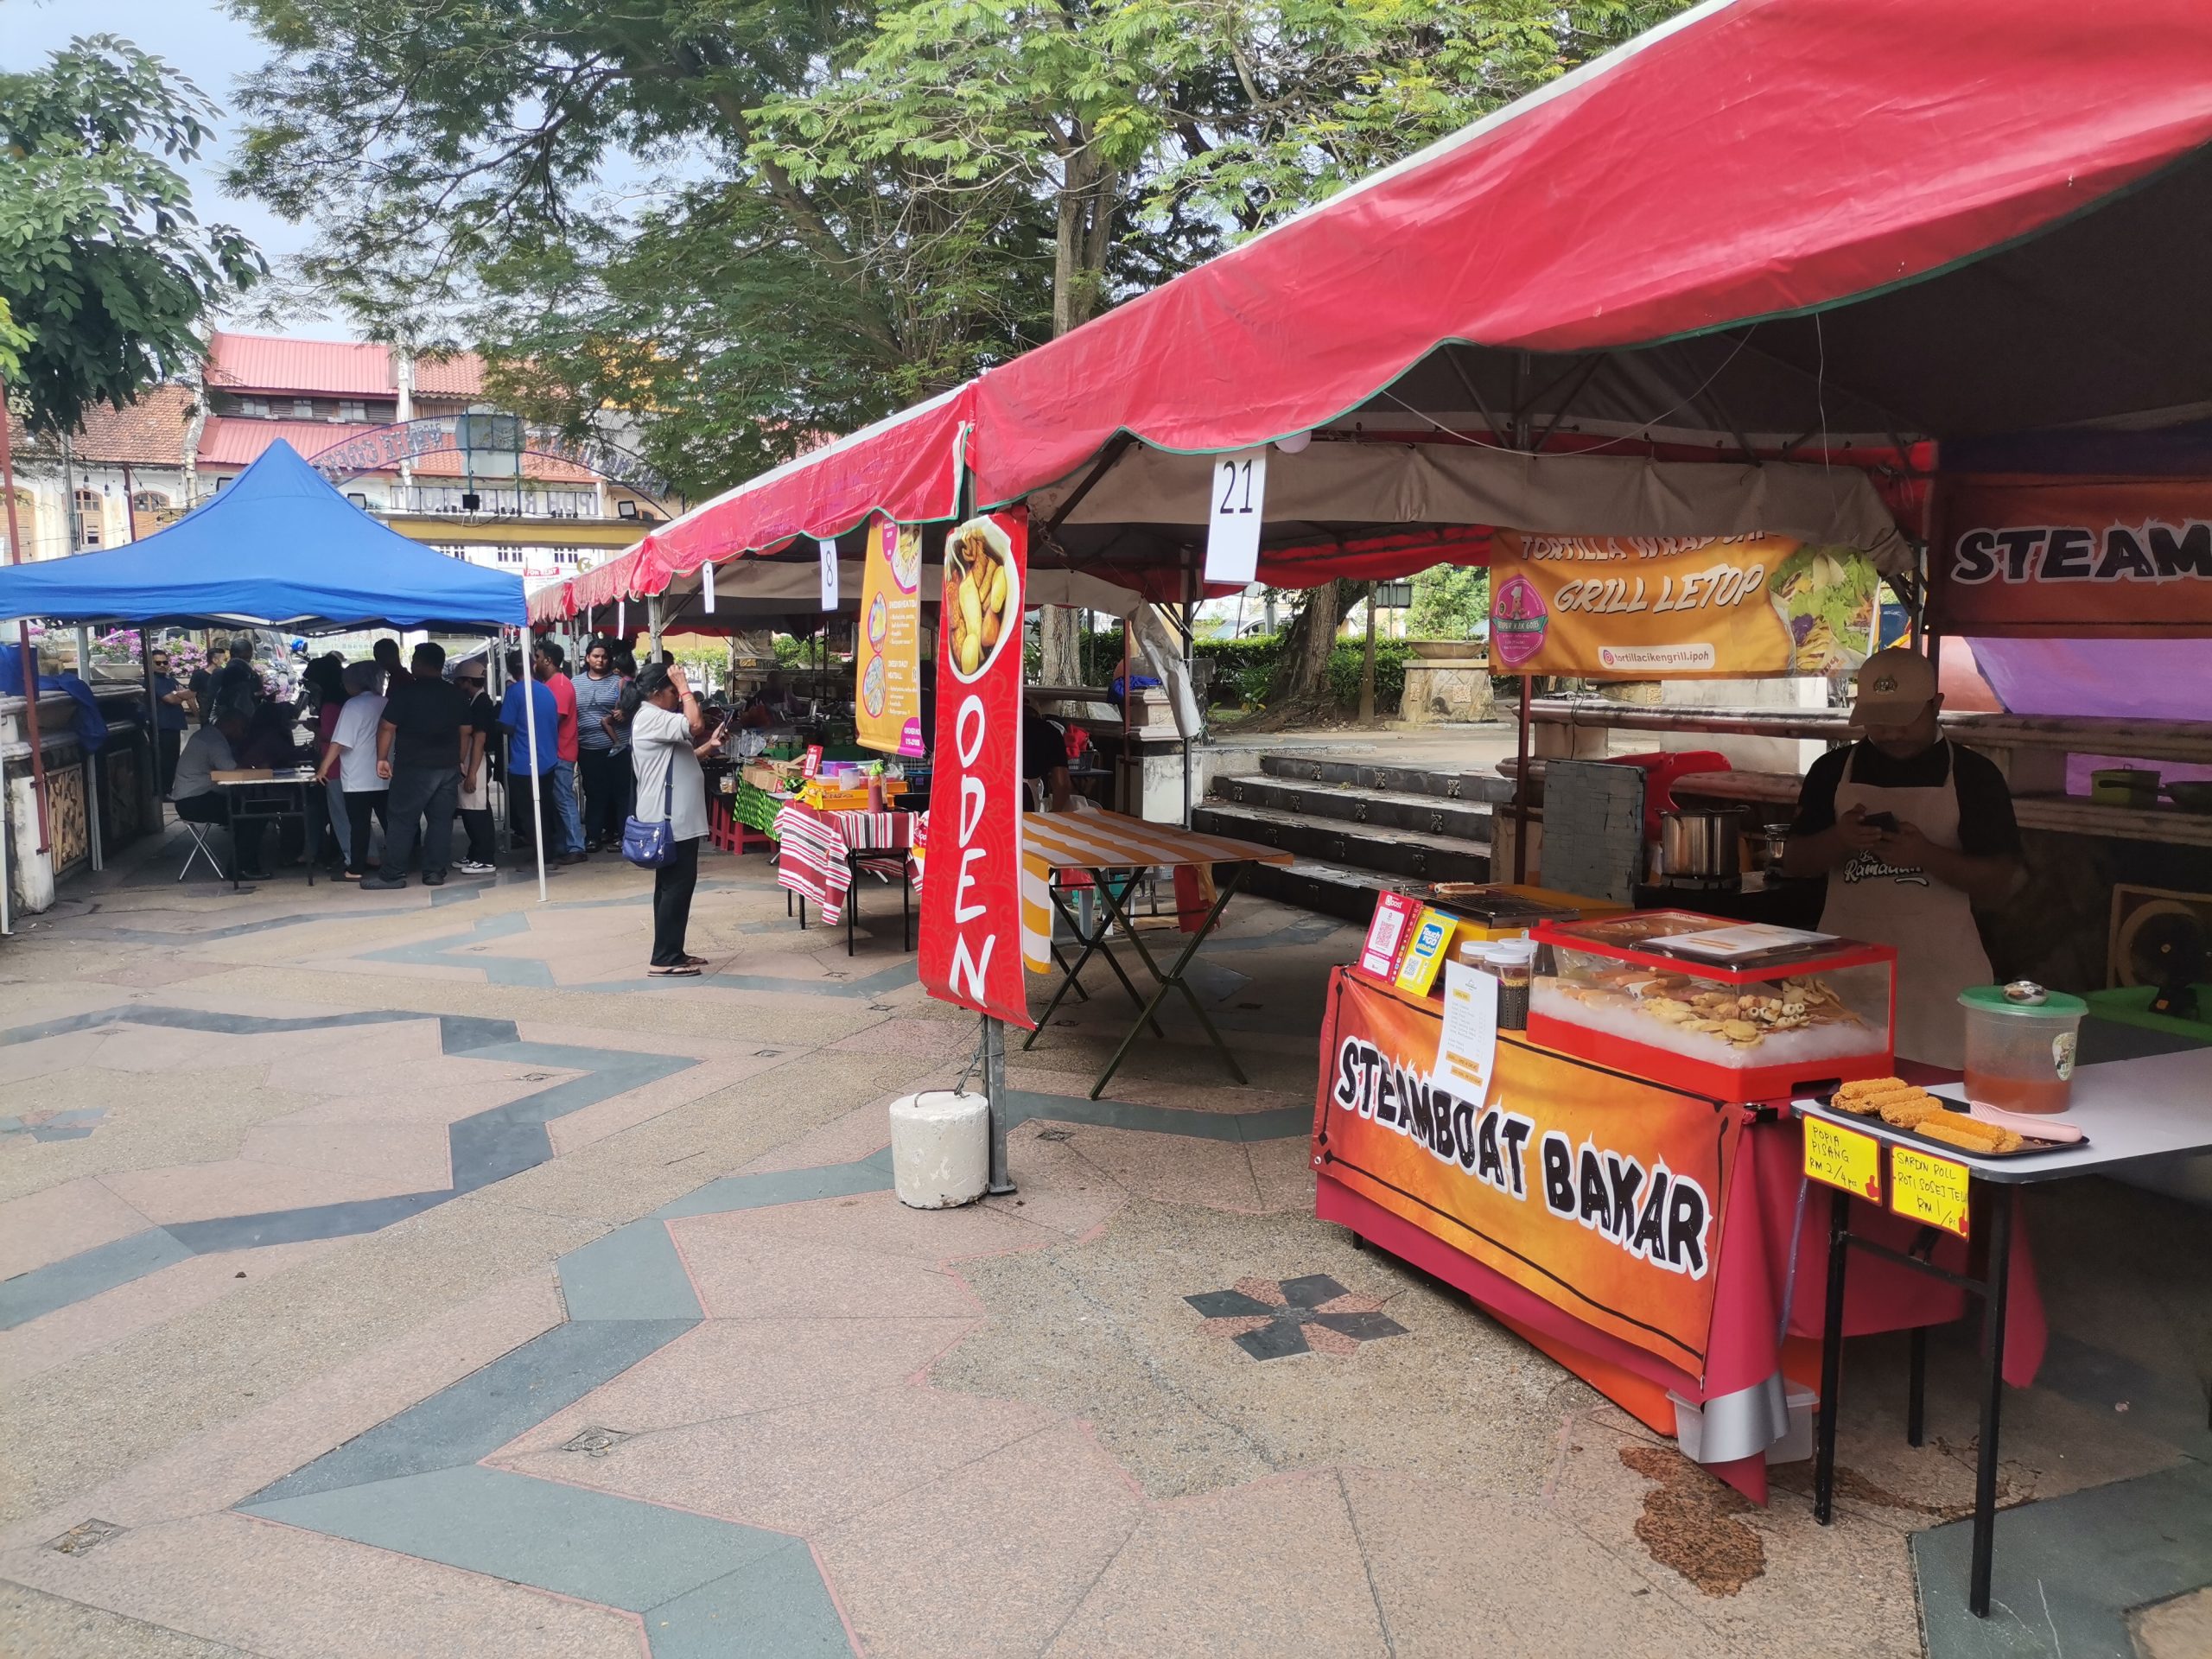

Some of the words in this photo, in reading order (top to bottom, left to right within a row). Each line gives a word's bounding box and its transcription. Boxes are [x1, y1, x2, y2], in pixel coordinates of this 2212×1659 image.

[1220, 459, 1253, 514] 21
[1521, 536, 1627, 560] TORTILLA
[1951, 522, 2212, 584] STEAM
[826, 550, 833, 587] 8
[1554, 577, 1649, 613] GRILL
[1652, 563, 1765, 613] LETOP
[950, 694, 996, 1008] ODEN
[1845, 859, 1922, 882] Rama
[1812, 1125, 1840, 1147] POPIA
[1334, 1035, 1535, 1200] STEAMBOAT
[1541, 1131, 1711, 1281] BAKAR
[1809, 1156, 1822, 1171] RM
[1811, 1139, 1850, 1163] PISANG
[1897, 1152, 1929, 1172] SARDIN
[1934, 1164, 1956, 1179] ROLL
[1897, 1172, 1916, 1190] ROTI
[1916, 1195, 1932, 1214] RM
